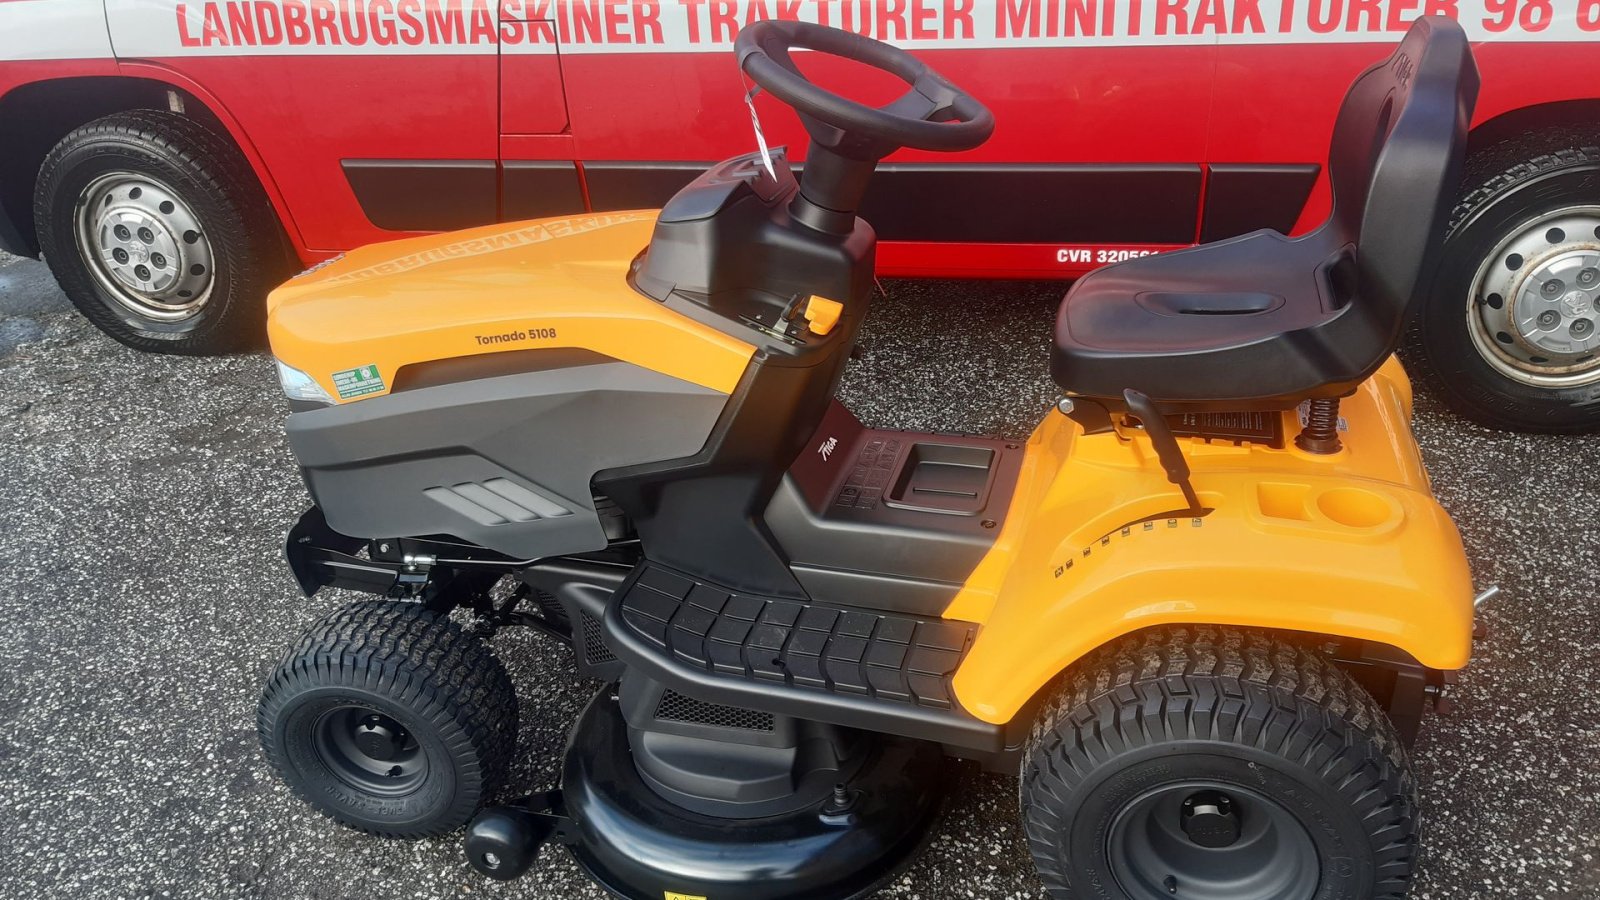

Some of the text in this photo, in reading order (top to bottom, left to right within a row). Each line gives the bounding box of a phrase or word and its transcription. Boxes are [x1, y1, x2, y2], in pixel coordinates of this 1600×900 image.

[176, 0, 664, 46] LANDBRUGSMASKINER
[1482, 0, 1553, 32] 98
[1057, 249, 1159, 263] CVR 3205
[475, 328, 556, 345] Tornado 5108
